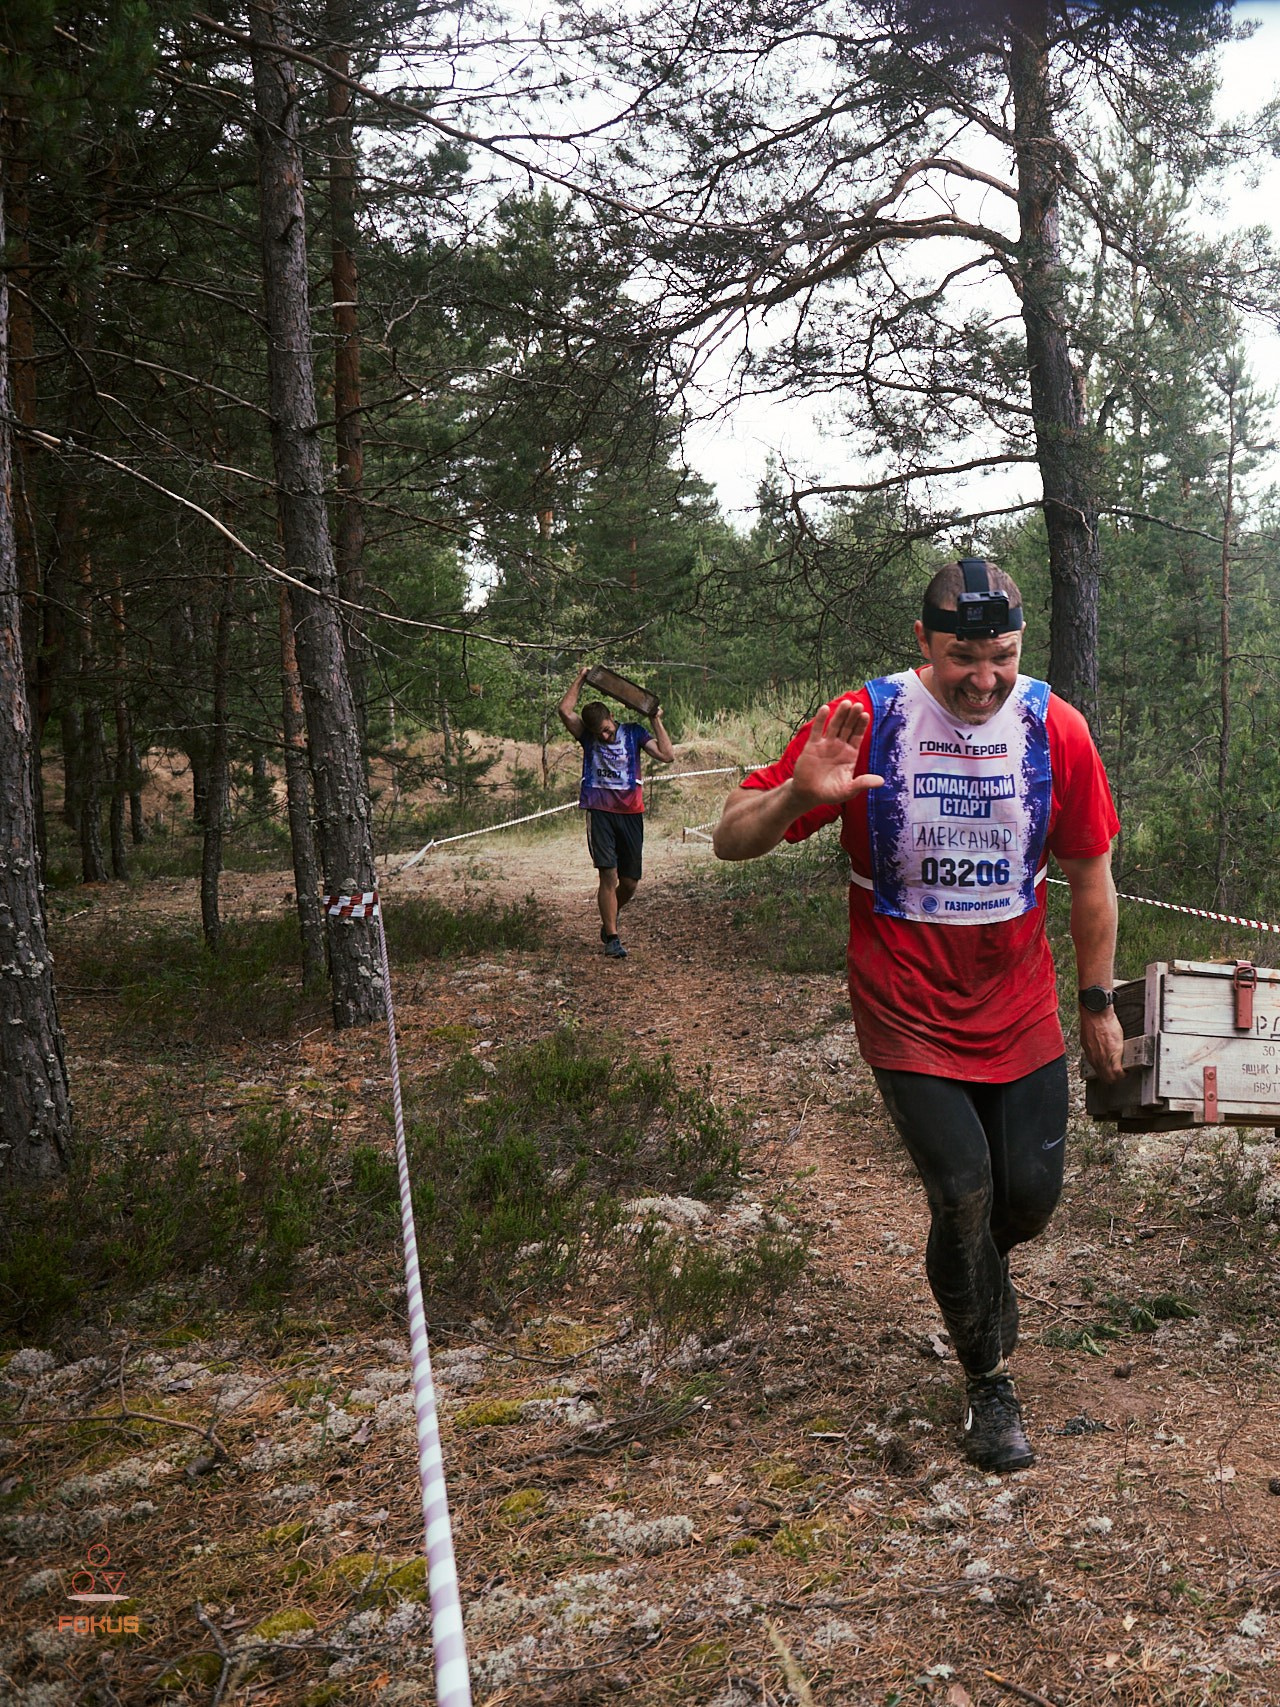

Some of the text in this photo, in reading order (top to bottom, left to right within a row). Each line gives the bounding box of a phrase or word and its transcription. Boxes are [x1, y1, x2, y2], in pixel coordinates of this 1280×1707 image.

[919, 741, 1007, 755] ГОНКА ГЕРОЕВ
[915, 774, 1014, 799] КОМАНДНЫЙ
[942, 798, 988, 816] СТАРТ
[915, 825, 1012, 851] АЛЕКСАНДР
[921, 857, 1010, 887] 03206
[944, 897, 1011, 911] ГАЗПРОМБАНК
